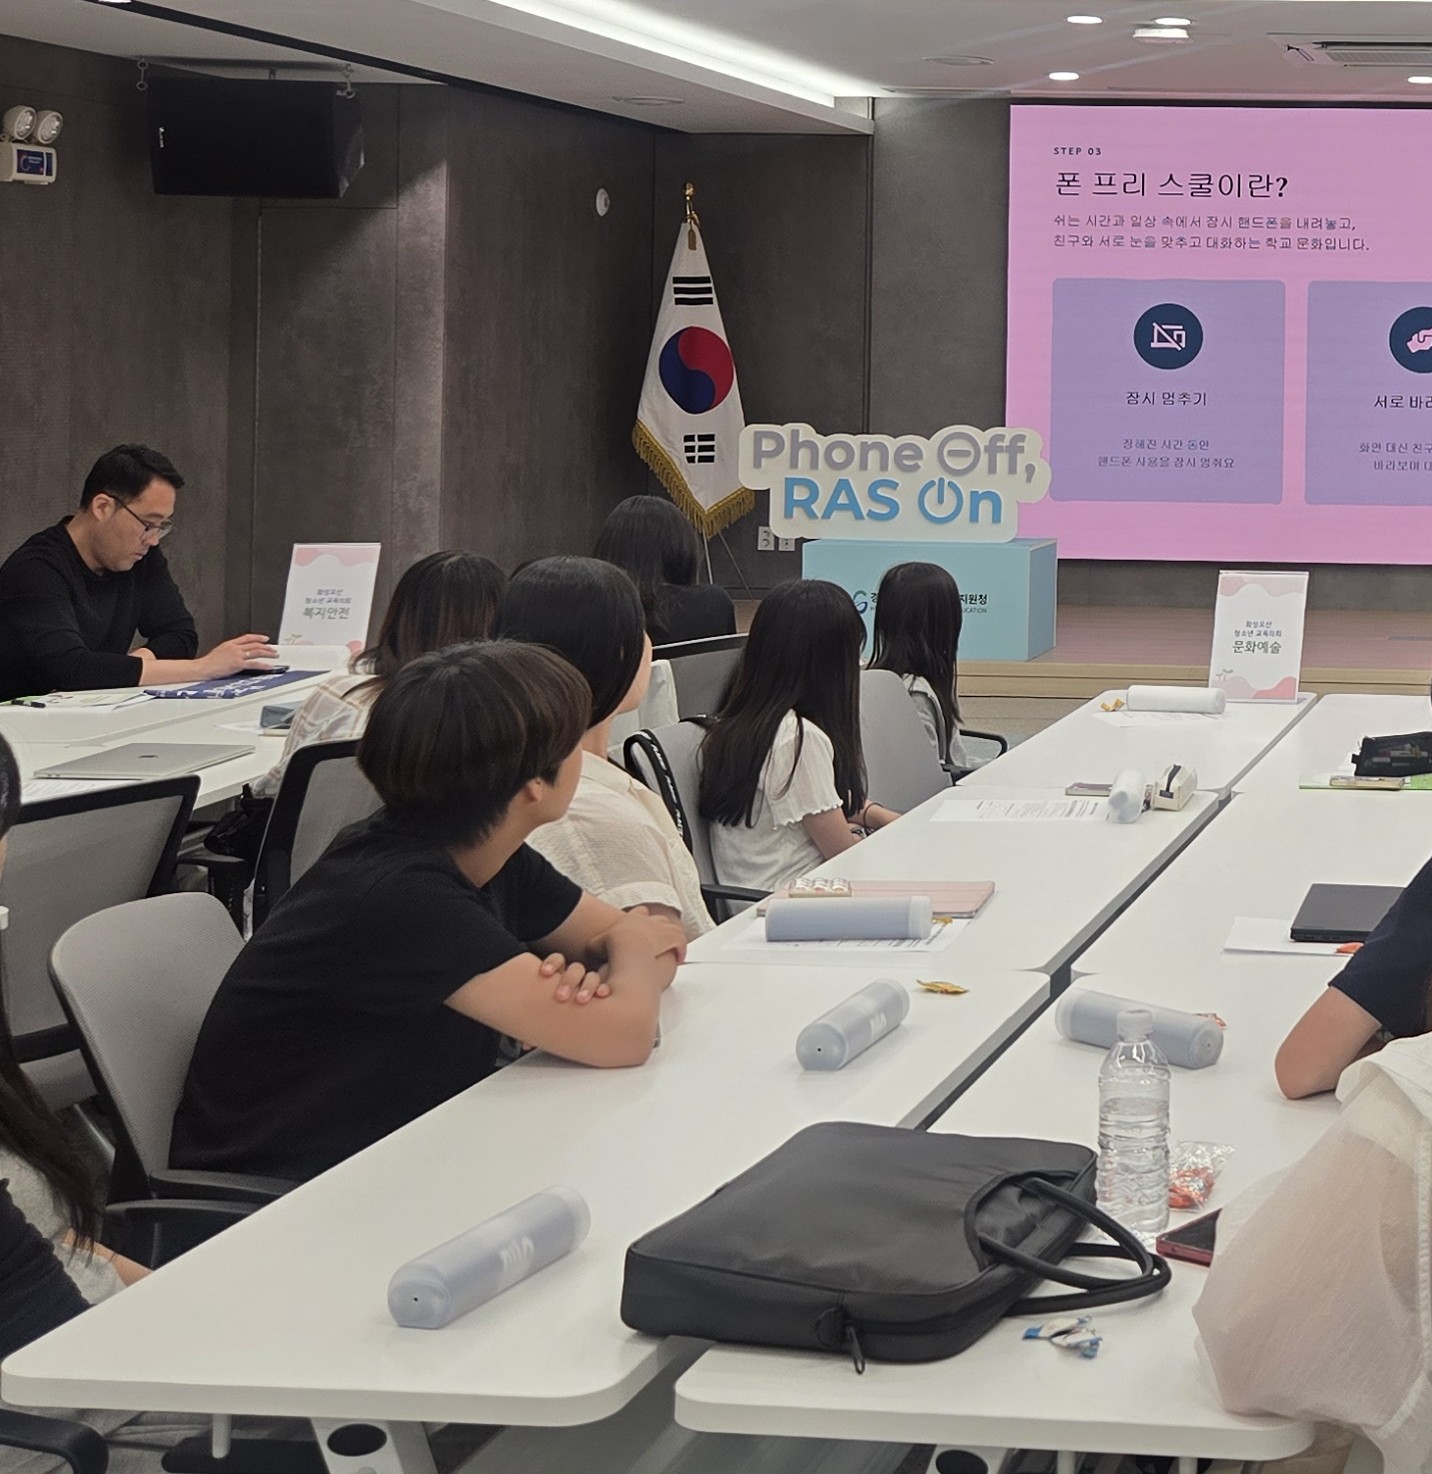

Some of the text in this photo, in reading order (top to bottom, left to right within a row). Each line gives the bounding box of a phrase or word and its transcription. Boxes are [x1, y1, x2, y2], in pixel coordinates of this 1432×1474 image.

[1053, 146, 1102, 156] STEP 03
[1055, 172, 1289, 199] 폰 프리 스쿨이란?
[1053, 214, 1356, 232] 쉬는 시간과 일상 속에서 잠시 핸드폰을 내려놓고,
[1053, 234, 1370, 252] 친구와 서로 눈을 맞추고 대화하는 학교 문화입니다.
[1125, 391, 1207, 407] 잠시 멈추기
[1373, 394, 1405, 409] 서로
[752, 429, 1037, 483] Phone Off,
[783, 476, 1003, 525] RAS On
[1232, 640, 1282, 655] 문화예술
